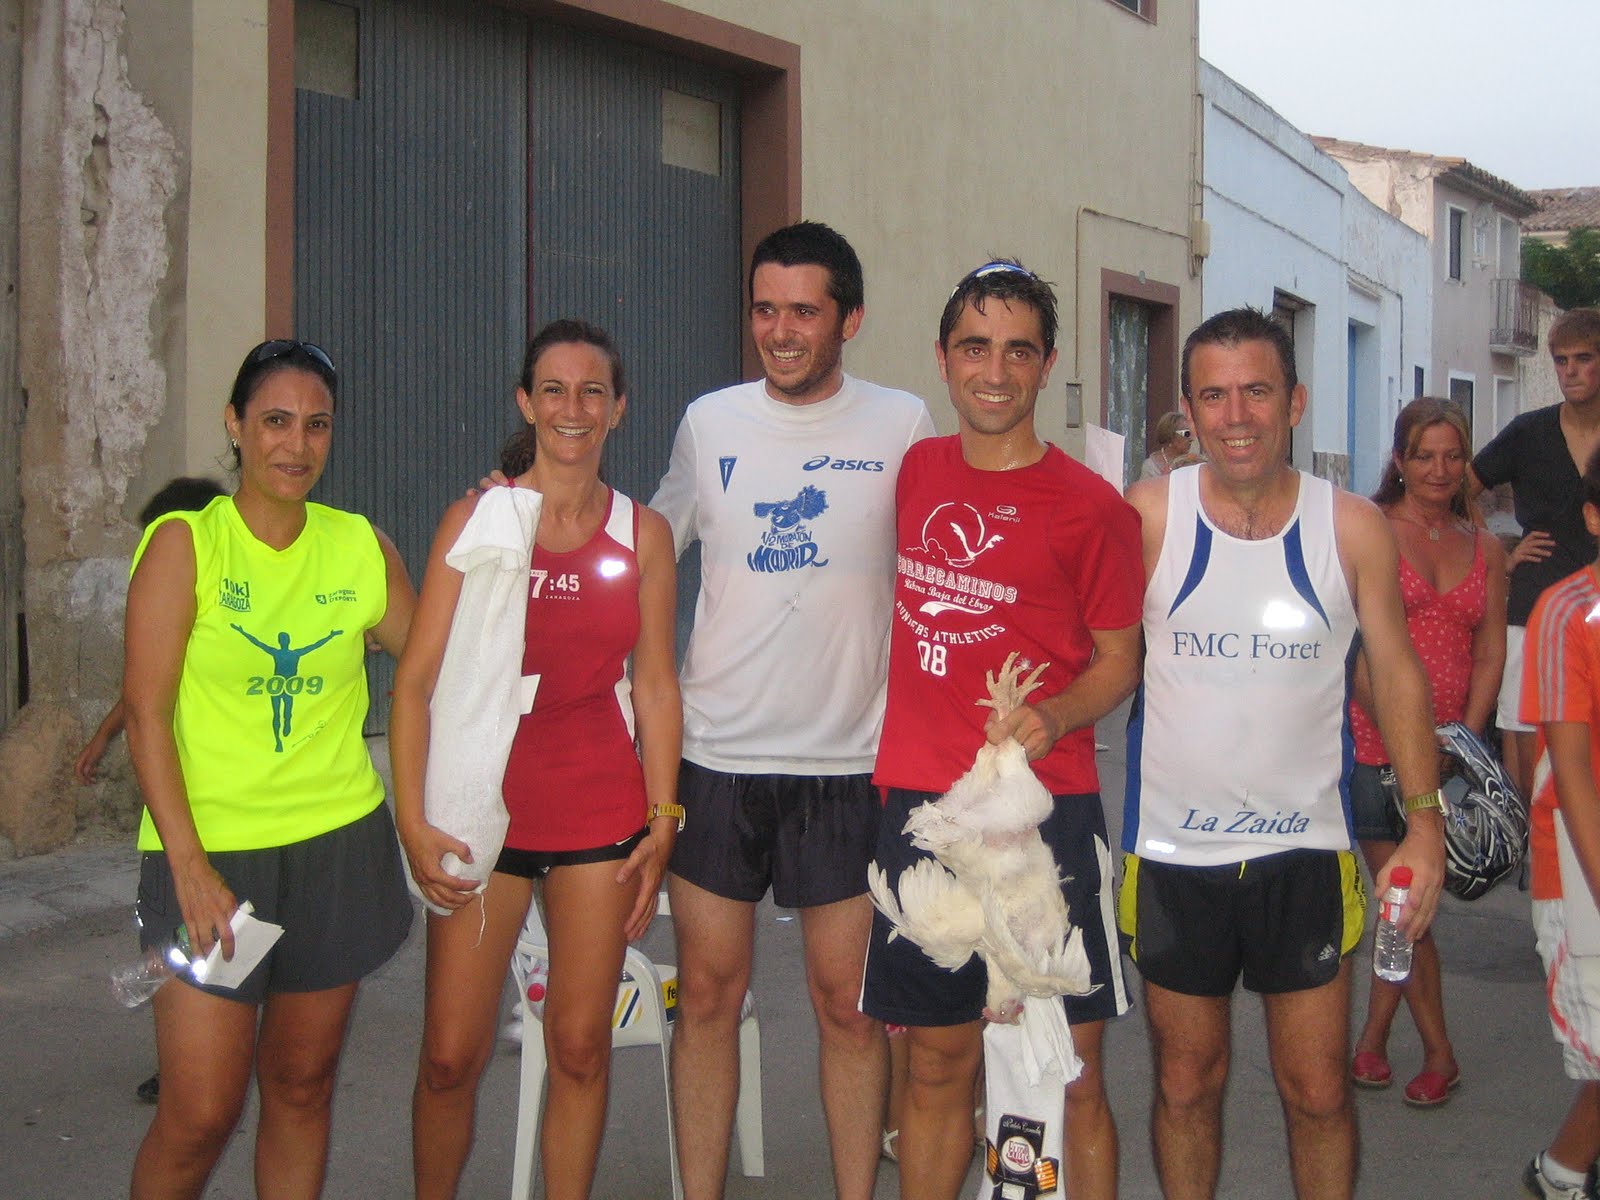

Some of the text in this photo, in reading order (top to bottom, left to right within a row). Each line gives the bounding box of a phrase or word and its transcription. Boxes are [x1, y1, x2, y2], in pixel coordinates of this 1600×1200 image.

[831, 459, 884, 472] asics
[927, 586, 951, 602] Baja
[953, 594, 967, 605] del
[968, 597, 990, 610] Ebro
[932, 624, 1006, 644] ATHLETICS
[1172, 631, 1321, 659] FMC Foret
[917, 640, 947, 677] 08
[247, 676, 323, 695] 2009
[1179, 808, 1310, 834] La Zaida
